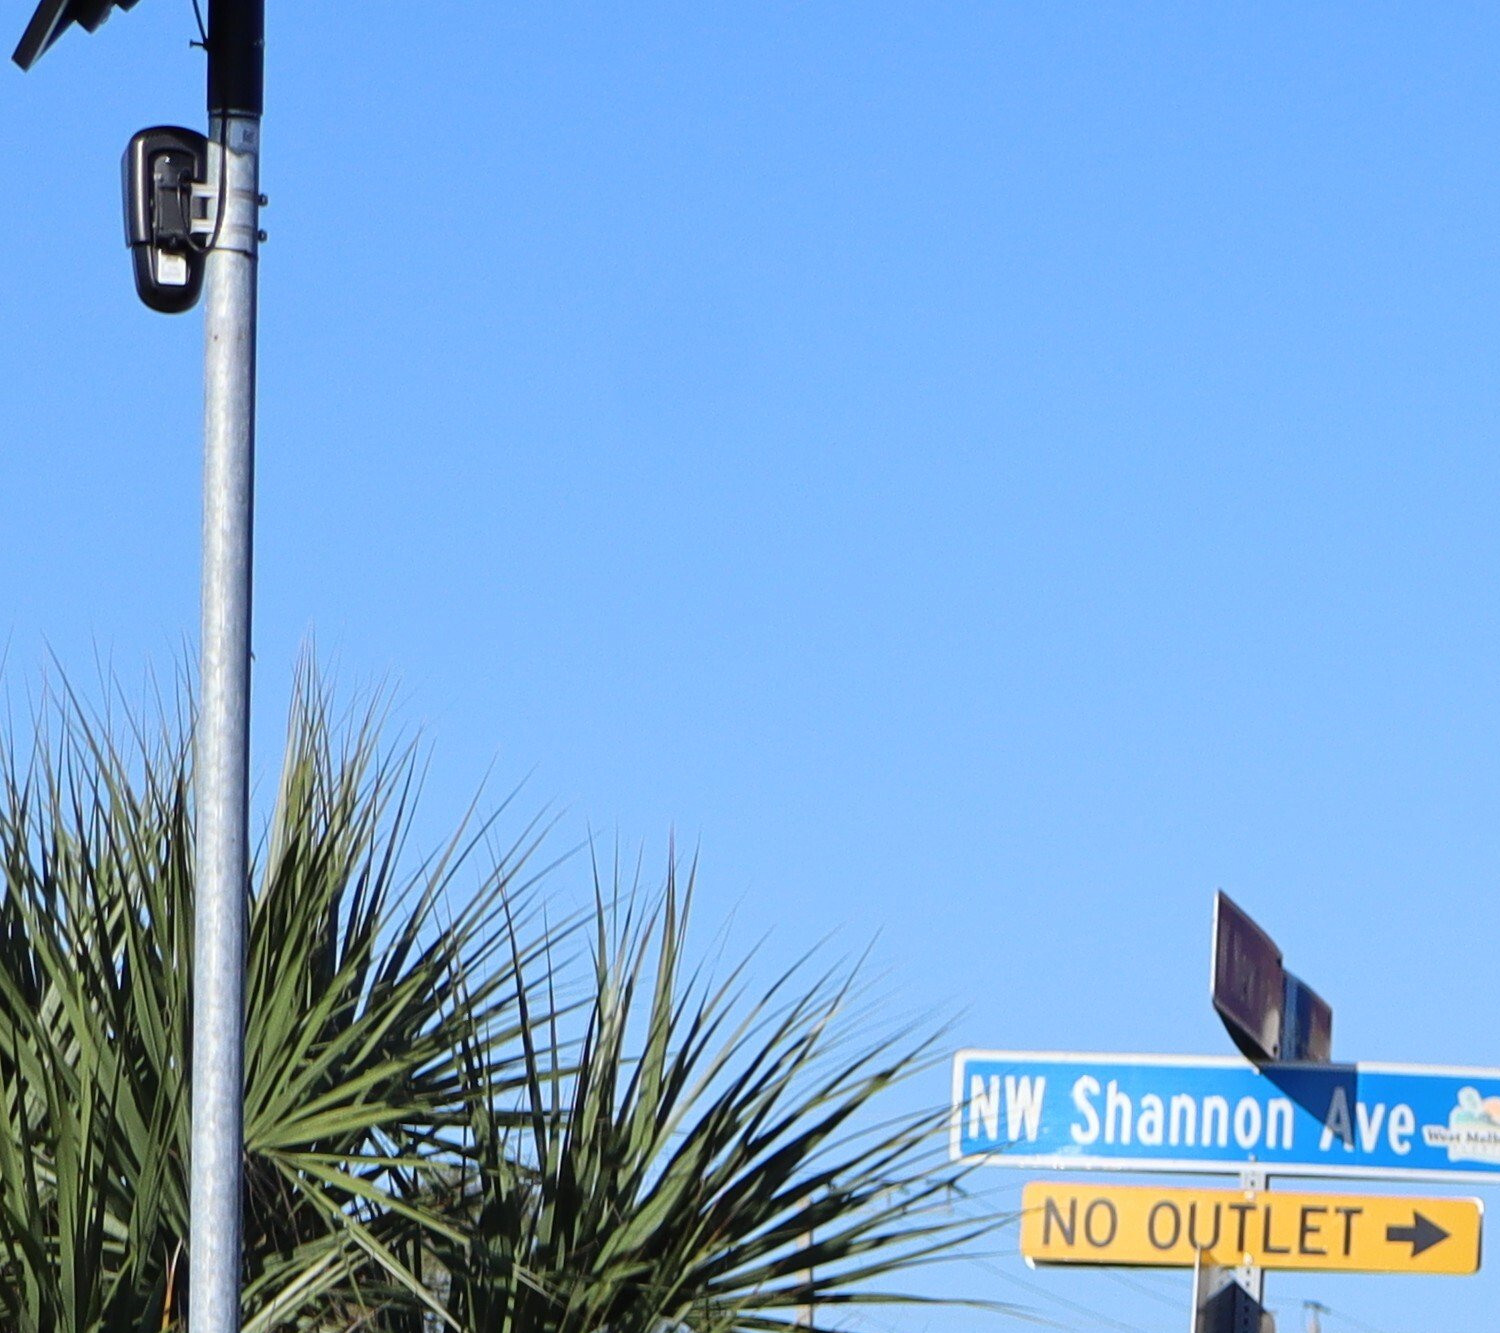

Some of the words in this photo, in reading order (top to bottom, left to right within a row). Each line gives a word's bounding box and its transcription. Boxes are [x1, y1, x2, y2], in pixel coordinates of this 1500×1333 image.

[969, 1075, 1045, 1142] NW
[1071, 1075, 1294, 1150] Shannon
[1319, 1086, 1416, 1155] Ave
[1042, 1197, 1118, 1248] NO
[1147, 1200, 1363, 1256] OUTLET
